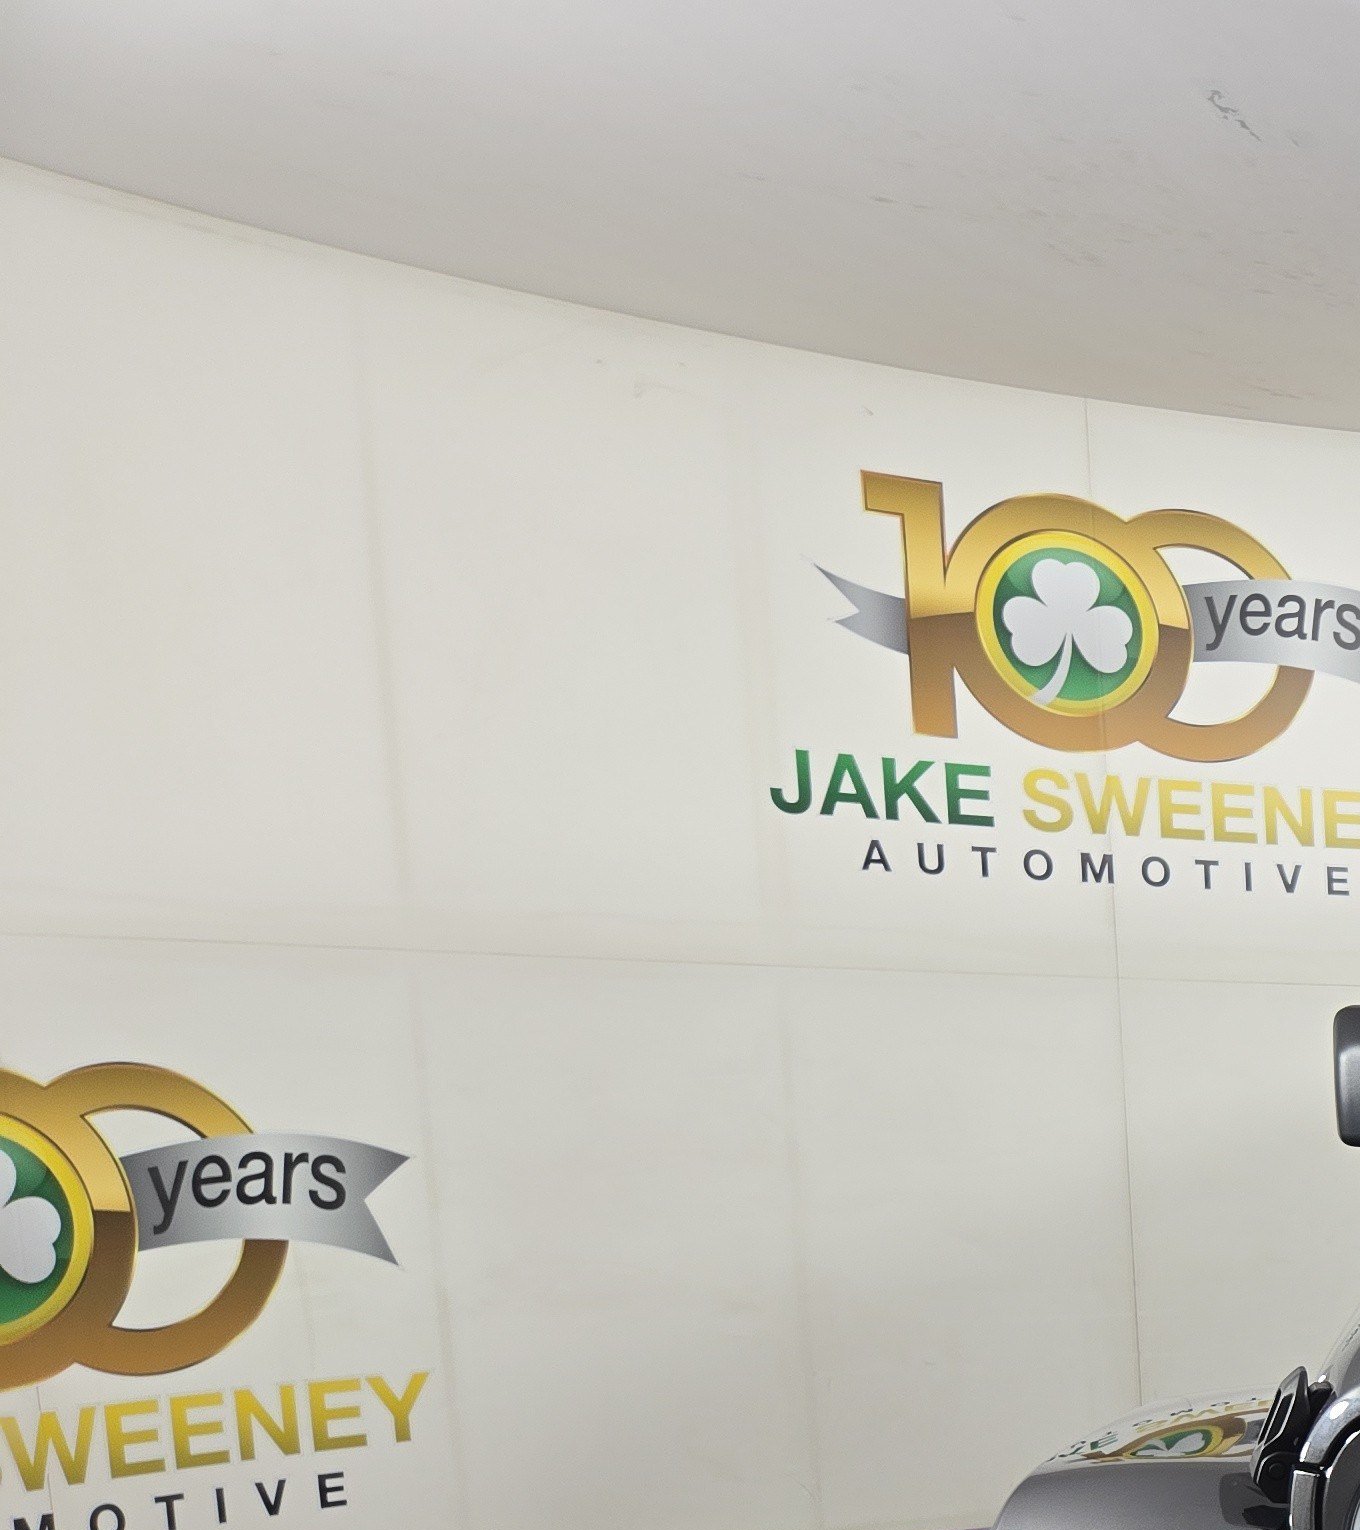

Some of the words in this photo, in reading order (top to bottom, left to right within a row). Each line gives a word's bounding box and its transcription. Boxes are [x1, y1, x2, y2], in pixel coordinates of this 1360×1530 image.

[770, 749, 996, 828] JAKE
[862, 839, 1351, 897] AUTOMOTIVE
[148, 1150, 348, 1236] years
[0, 1370, 429, 1493] WEENEY
